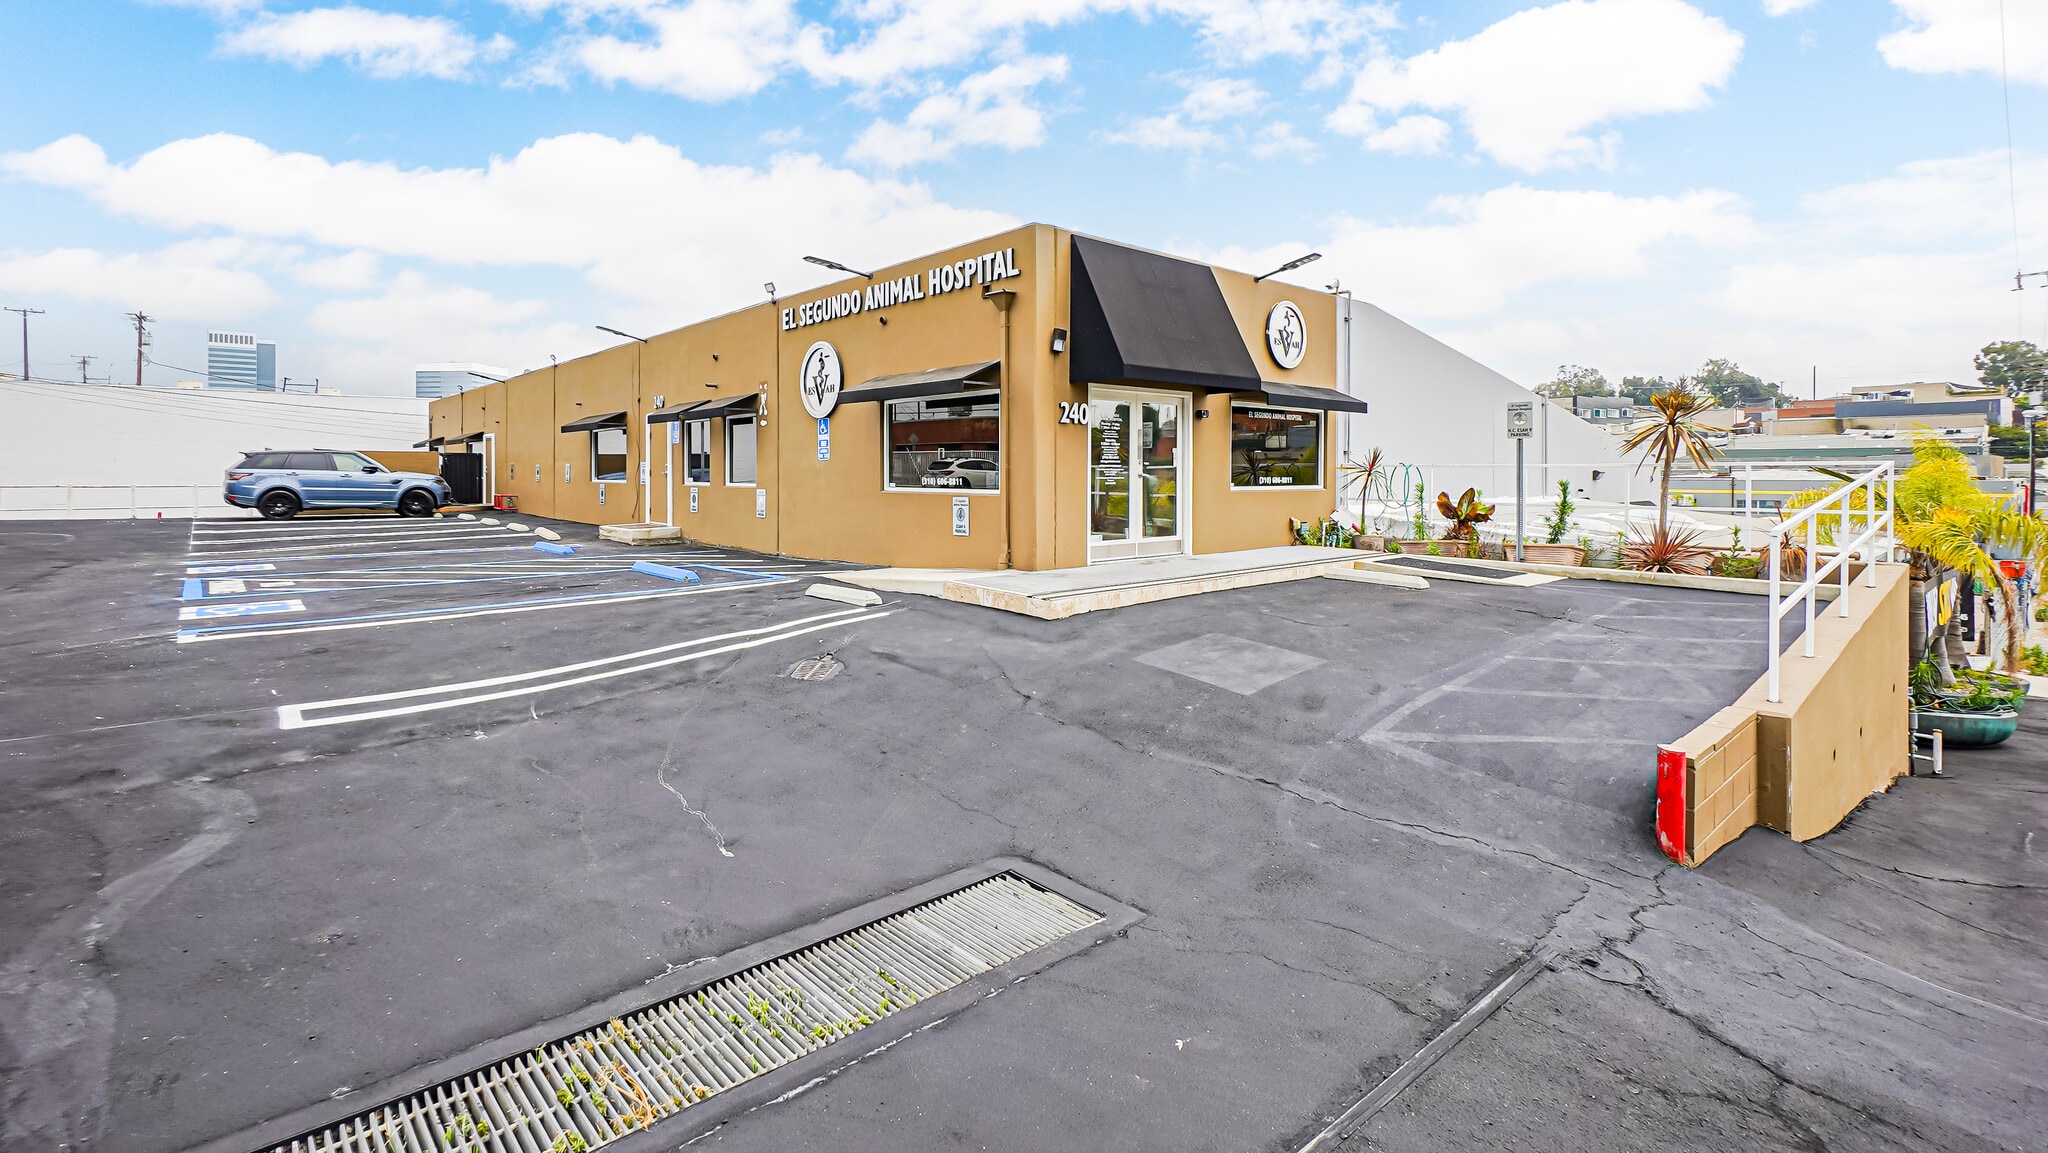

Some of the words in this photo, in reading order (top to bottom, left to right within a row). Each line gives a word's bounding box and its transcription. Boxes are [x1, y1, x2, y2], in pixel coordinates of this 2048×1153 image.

[782, 308, 797, 331] EL
[799, 289, 861, 328] SEGUNDO
[864, 273, 924, 312] ANIMAL
[928, 247, 1020, 296] HOSPITAL
[1059, 401, 1089, 425] 240
